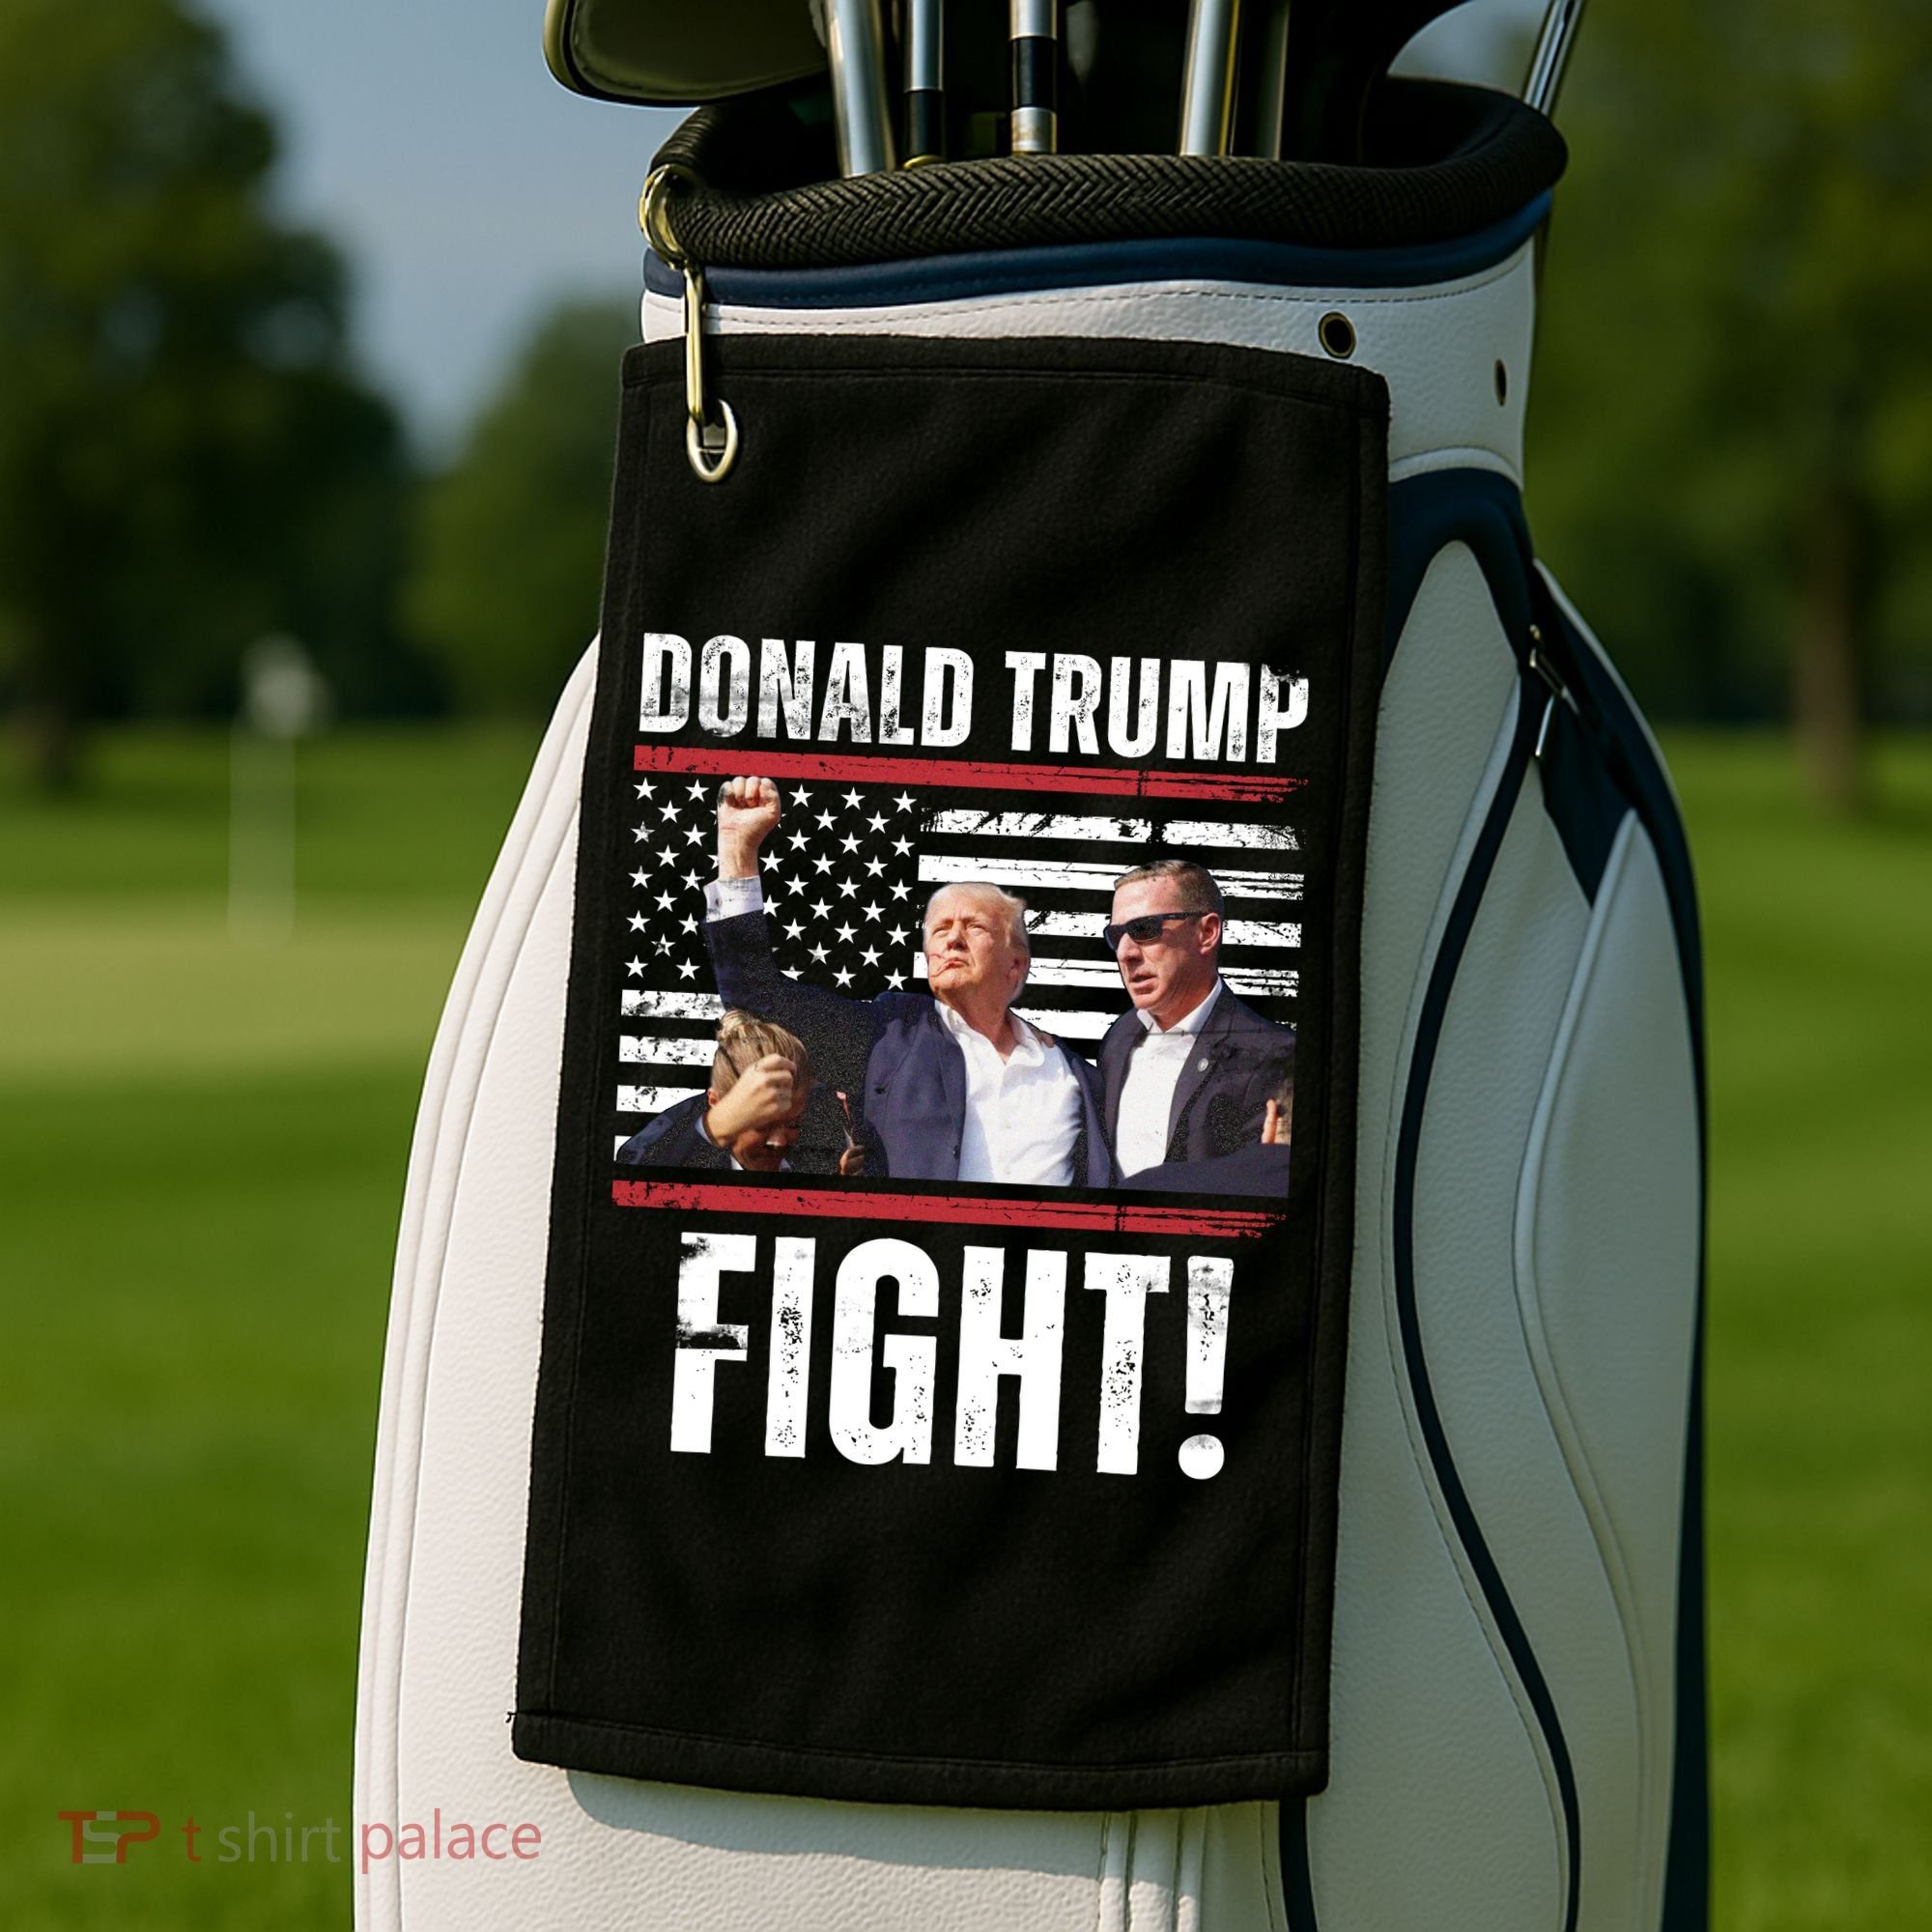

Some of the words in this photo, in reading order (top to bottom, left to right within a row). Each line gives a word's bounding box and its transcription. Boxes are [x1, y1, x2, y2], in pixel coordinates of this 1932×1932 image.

[639, 632, 975, 748] DONALD
[1005, 650, 1310, 764] TRUMP
[669, 1232, 1235, 1480] FIGHT!
